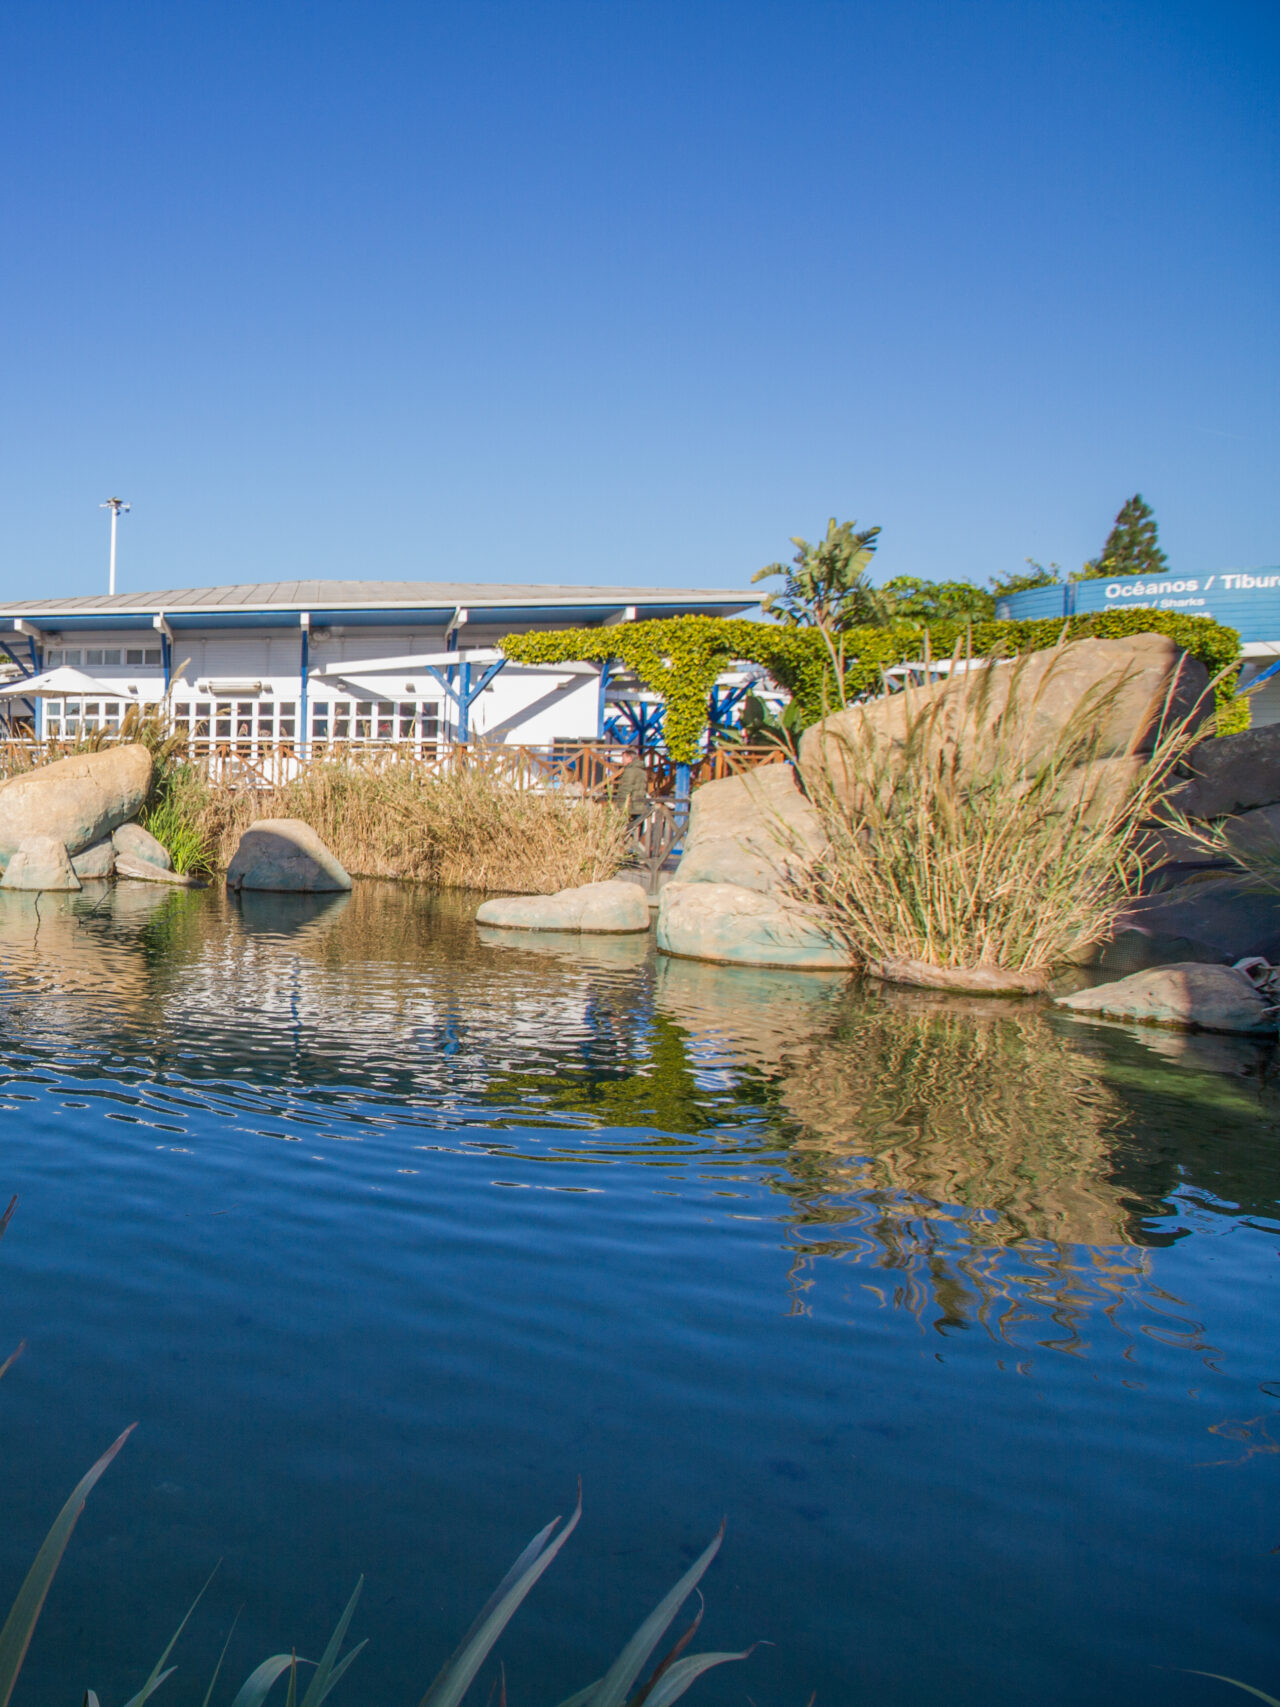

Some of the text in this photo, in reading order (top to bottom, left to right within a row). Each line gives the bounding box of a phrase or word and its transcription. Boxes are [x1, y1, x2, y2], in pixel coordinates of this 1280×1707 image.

[1105, 573, 1280, 598] Océanos / Tibur
[1160, 598, 1206, 609] Sharks
